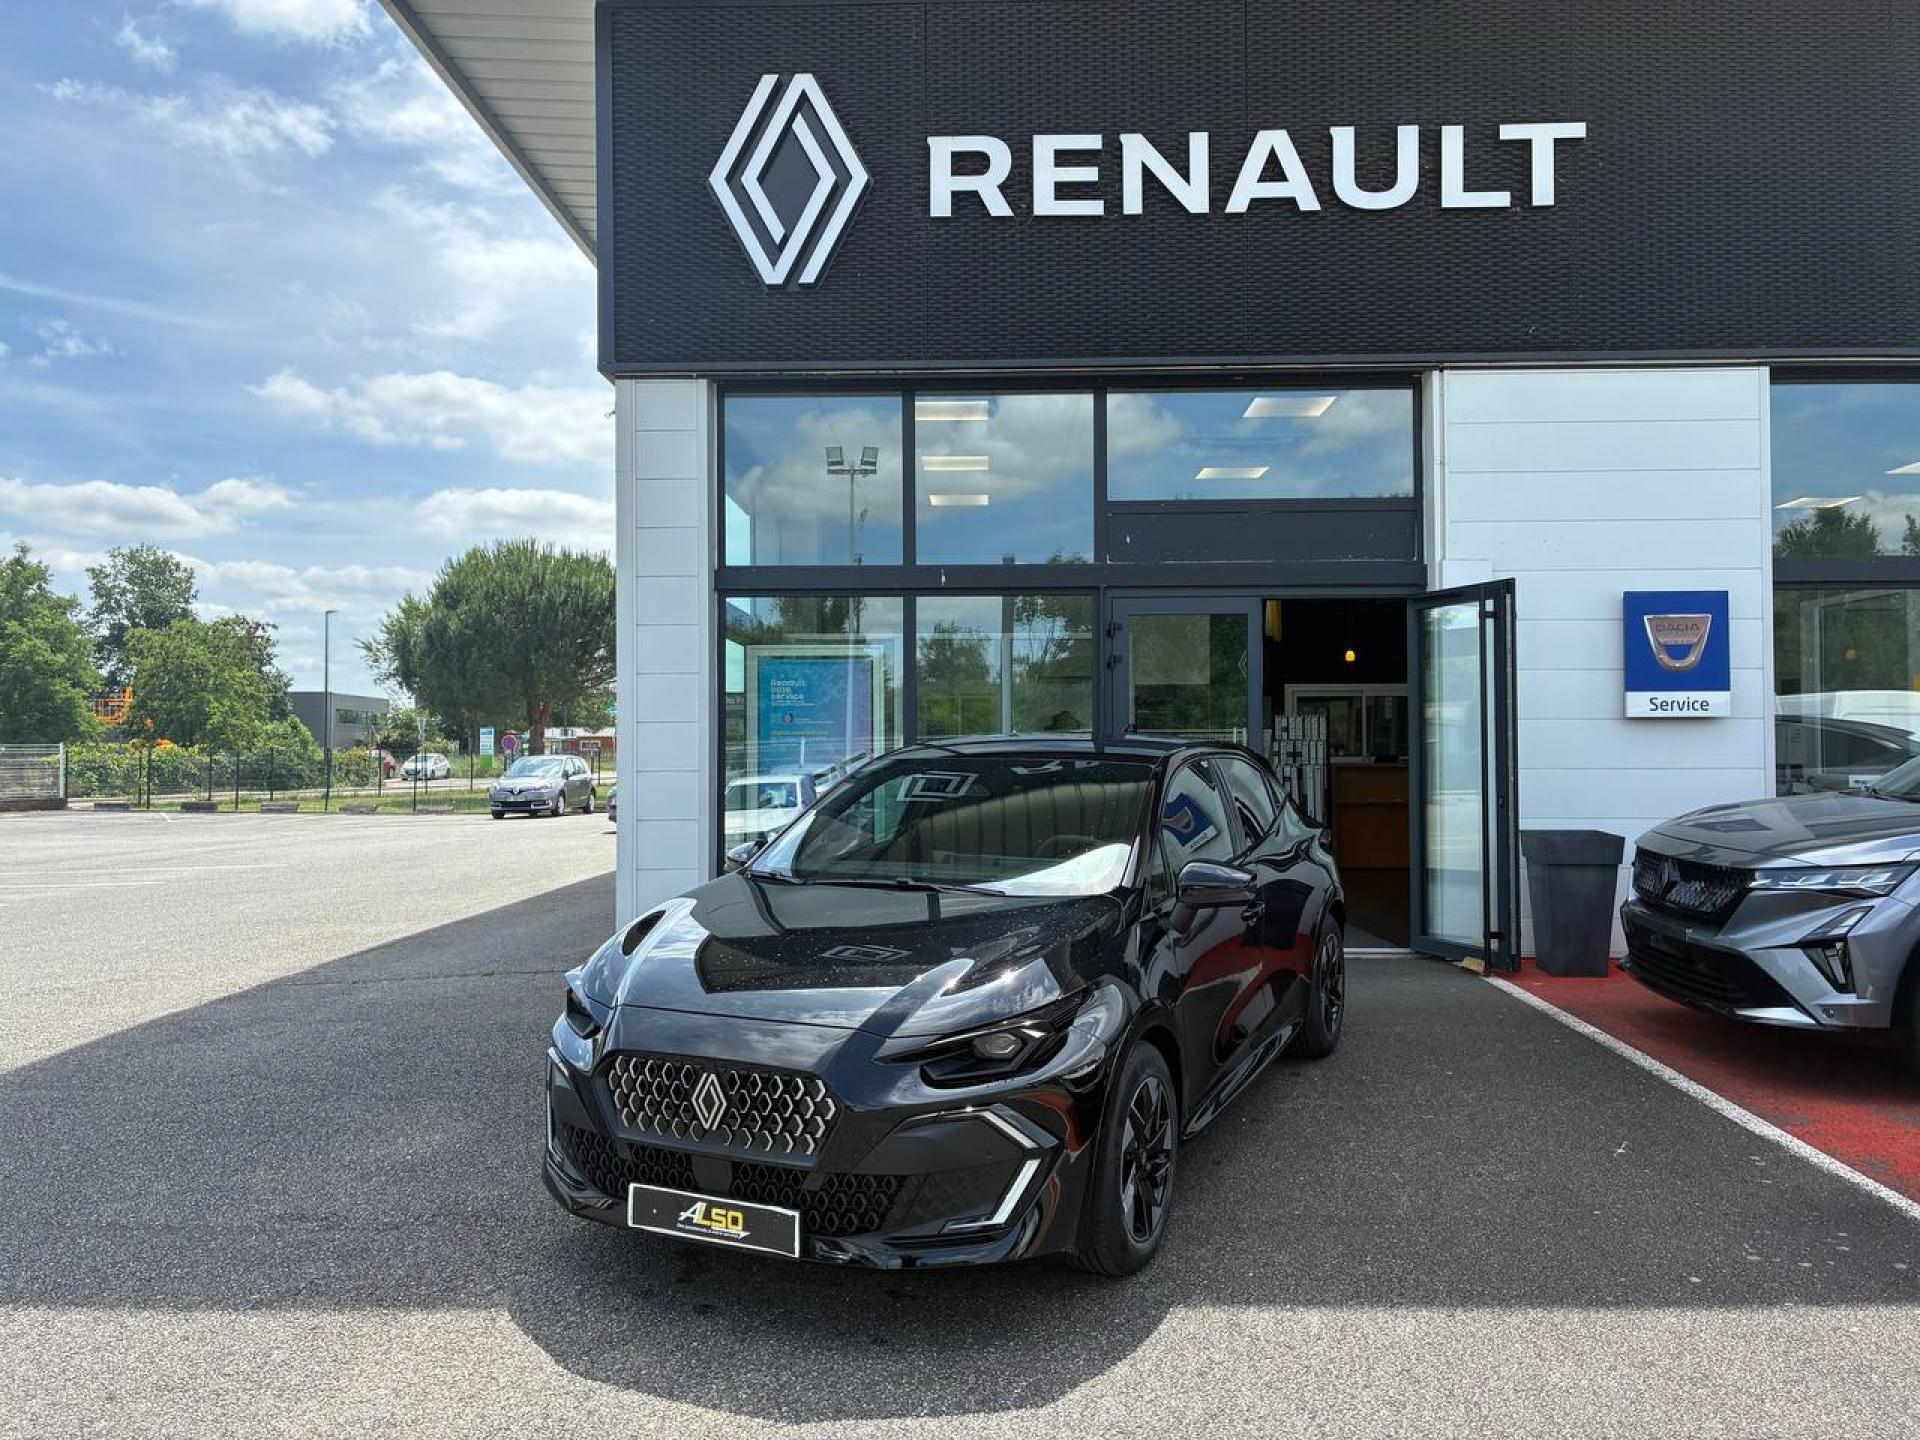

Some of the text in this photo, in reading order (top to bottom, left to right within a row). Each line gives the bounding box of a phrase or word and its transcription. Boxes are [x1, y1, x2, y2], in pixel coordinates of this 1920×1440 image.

[926, 122, 1587, 218] RENAULT
[1649, 696, 1710, 712] Service
[677, 1201, 743, 1231] ALSO
